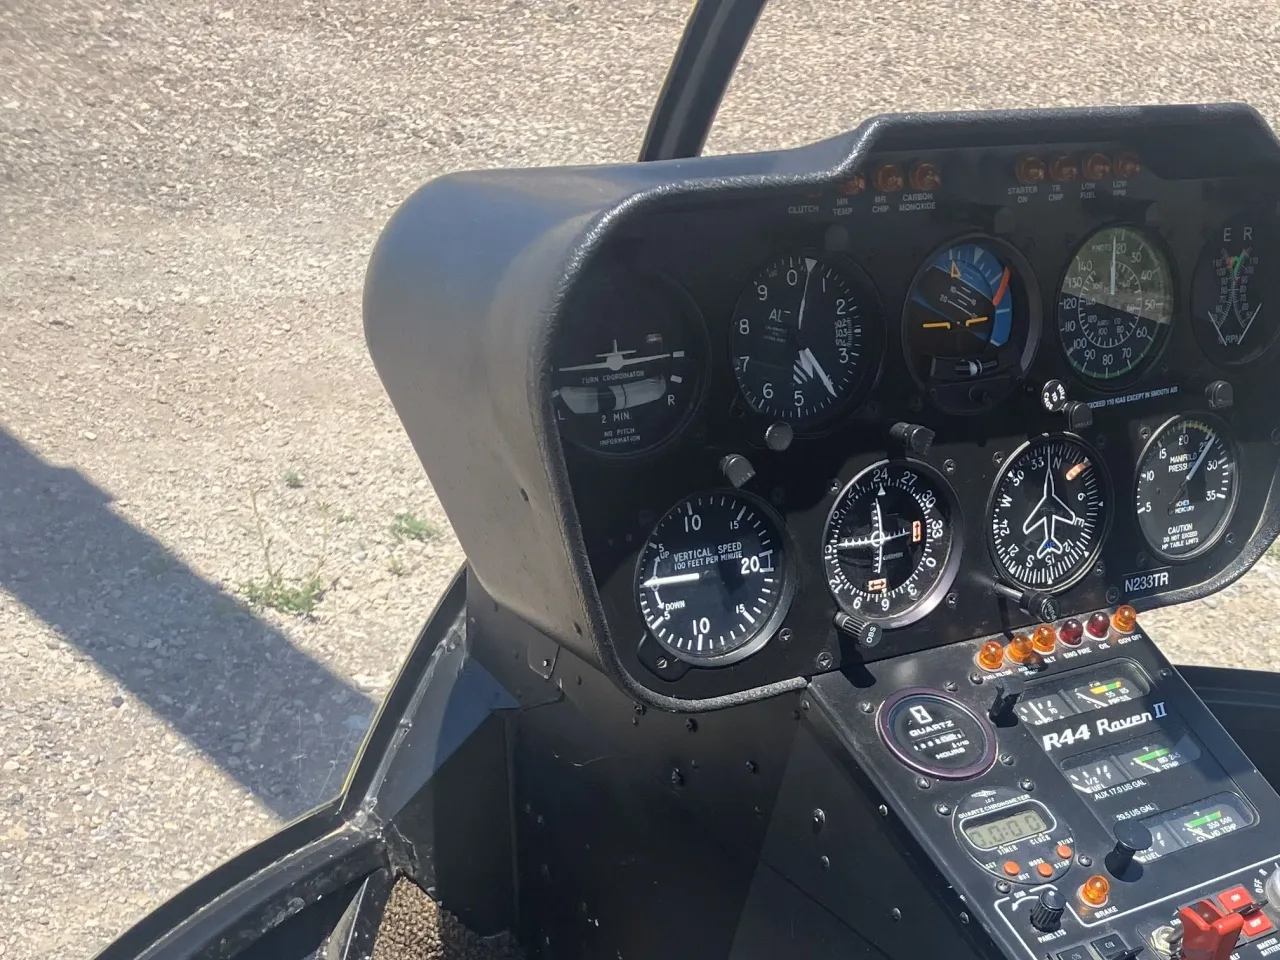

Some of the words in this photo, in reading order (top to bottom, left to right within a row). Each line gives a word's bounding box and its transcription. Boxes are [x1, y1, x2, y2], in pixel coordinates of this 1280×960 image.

[902, 193, 934, 202] CARBON
[1008, 186, 1038, 196] STARTER
[788, 205, 819, 214] CLUTCH
[832, 207, 853, 217] TEMP
[871, 204, 890, 214] CHIP
[898, 201, 936, 212] MONOXIDE
[1223, 227, 1232, 242] E
[1243, 226, 1253, 240] R
[1131, 251, 1142, 263] 30
[1078, 260, 1093, 272] 140
[787, 268, 798, 286] 0
[1068, 276, 1083, 289] 130
[1141, 271, 1153, 281] 40
[757, 284, 768, 301] 9
[836, 298, 847, 315] 2
[1063, 298, 1077, 310] 120
[1144, 299, 1155, 310] 50
[739, 318, 750, 335] 8
[1136, 326, 1148, 339] 60
[1072, 337, 1087, 350] 100
[838, 347, 849, 364] 3
[1084, 348, 1096, 361] 90
[1102, 353, 1114, 366] 80
[1122, 347, 1132, 360] 70
[739, 355, 750, 372] 7
[602, 370, 645, 382] COORDINATOR
[762, 382, 774, 399] 6
[667, 394, 676, 406] R
[794, 390, 805, 407] 5
[599, 435, 641, 446] INFORMATION
[1178, 434, 1189, 446] 20
[1158, 447, 1167, 460] 15
[1031, 458, 1044, 471] 33
[1053, 458, 1062, 470] N
[1207, 459, 1218, 471] 30
[873, 467, 889, 482] 24
[900, 469, 919, 486] 27
[1011, 470, 1025, 487] 30
[1146, 470, 1155, 481] 10
[921, 489, 937, 508] 30
[1205, 490, 1217, 501] 35
[1145, 501, 1152, 512] 5
[684, 513, 702, 533] 10
[729, 520, 739, 531] 15
[931, 519, 943, 539] 33
[999, 518, 1011, 538] 24
[1167, 523, 1193, 535] CAUTION
[658, 543, 665, 552] 5
[673, 547, 713, 563] VERTICAL
[717, 541, 743, 554] SPEED
[1007, 543, 1020, 557] 21
[660, 551, 670, 560] UP
[674, 561, 686, 571] 100
[687, 557, 705, 569] FEET
[705, 555, 719, 566] PER
[720, 550, 744, 562] MINUTE
[1025, 553, 1036, 568] S
[1045, 553, 1056, 566] 15
[740, 556, 760, 575] 20
[925, 557, 937, 568] 0
[828, 575, 844, 595] 12
[1124, 572, 1169, 593] N233TR
[907, 583, 918, 596] 3
[665, 600, 686, 611] DOWN
[735, 603, 746, 614] 15
[664, 611, 671, 621] 5
[692, 617, 711, 636] 10
[866, 626, 877, 643] OBS
[909, 720, 954, 737] QUARTZ
[1042, 723, 1091, 751] R44
[1096, 711, 1152, 736] Raven
[1152, 702, 1168, 719] II
[935, 747, 966, 760] HOURS
[1085, 776, 1099, 786] 1/2
[1094, 791, 1109, 801] AUX
[1109, 786, 1123, 796] 17.0
[1122, 782, 1132, 790] US
[1131, 777, 1147, 788] GAL
[958, 807, 984, 819] QUARTZ
[984, 794, 1031, 811] CHRONOMETER
[1130, 809, 1140, 817] US
[1139, 804, 1155, 814] GAL
[1030, 834, 1051, 845] CLOCK
[997, 844, 1018, 855] TIMER
[1253, 878, 1264, 894] OFF
[1013, 890, 1026, 899] DIM
[1094, 906, 1118, 918] BRAKE
[1056, 929, 1067, 938] LTS
[1257, 938, 1278, 950] MASTER
